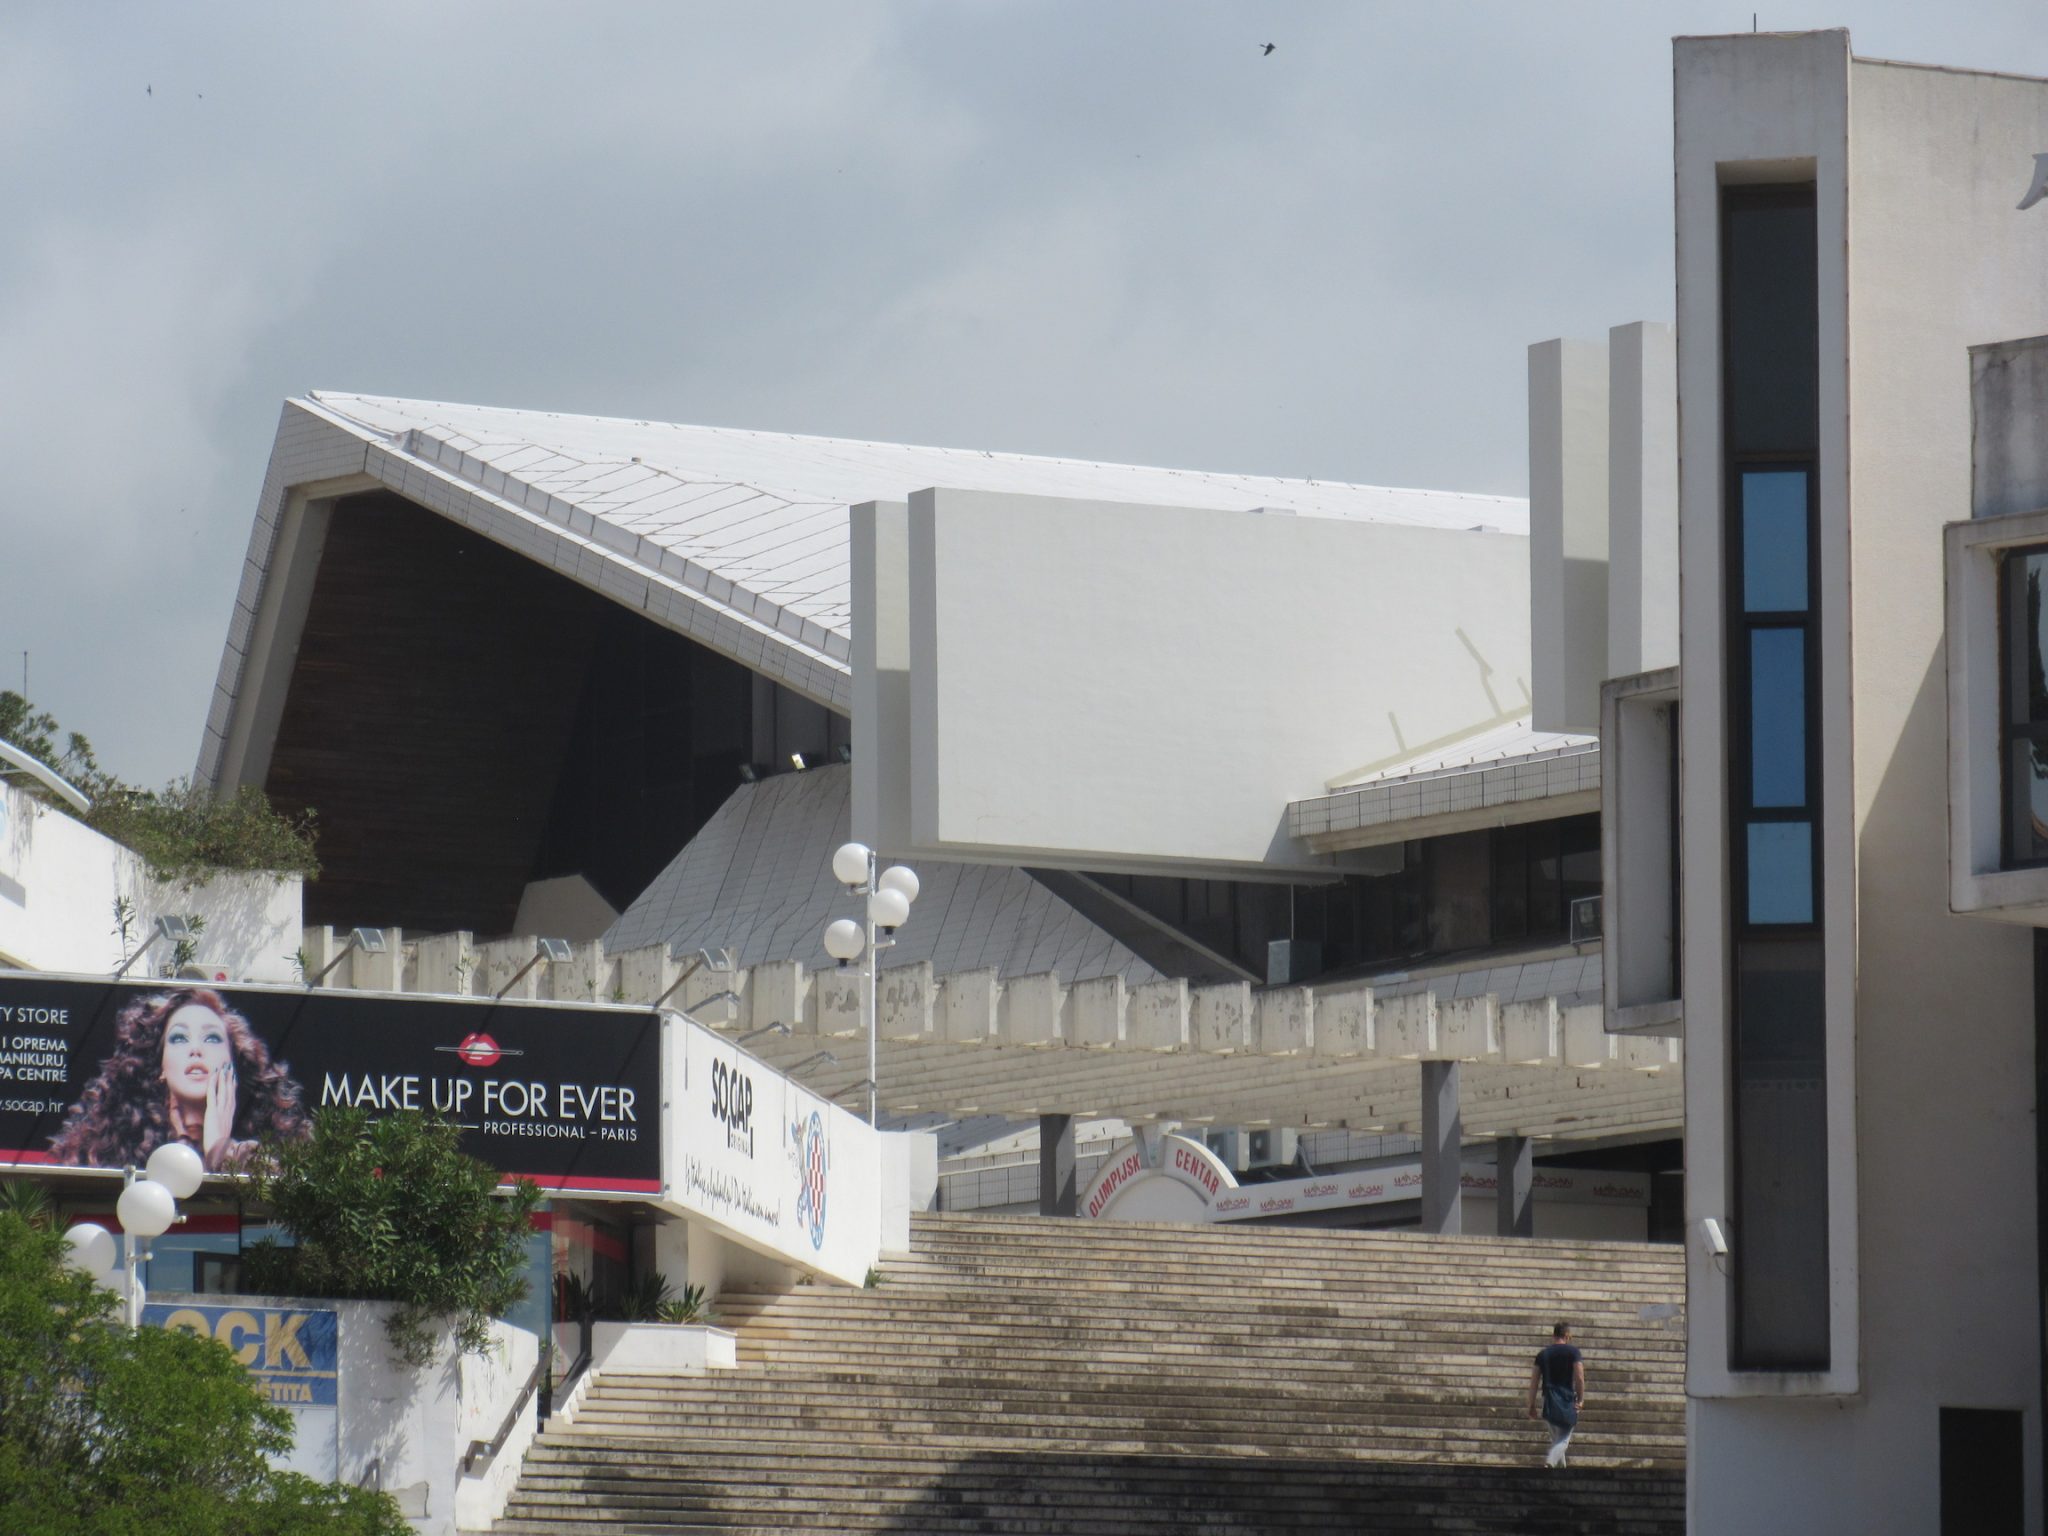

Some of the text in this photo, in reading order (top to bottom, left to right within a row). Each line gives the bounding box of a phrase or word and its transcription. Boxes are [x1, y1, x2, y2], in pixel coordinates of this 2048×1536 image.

[17, 1007, 69, 1025] STORE
[12, 1036, 68, 1052] OPREMA
[16, 1068, 67, 1082] CENTRE
[321, 1071, 637, 1122] MAKE UP FOR EVER
[711, 1056, 753, 1134] SOCAP
[0, 1098, 64, 1117] .socap.hr
[483, 1120, 586, 1139] PROFESSIONAL
[601, 1126, 638, 1142] PARIS
[1175, 1148, 1220, 1196] CENTAR
